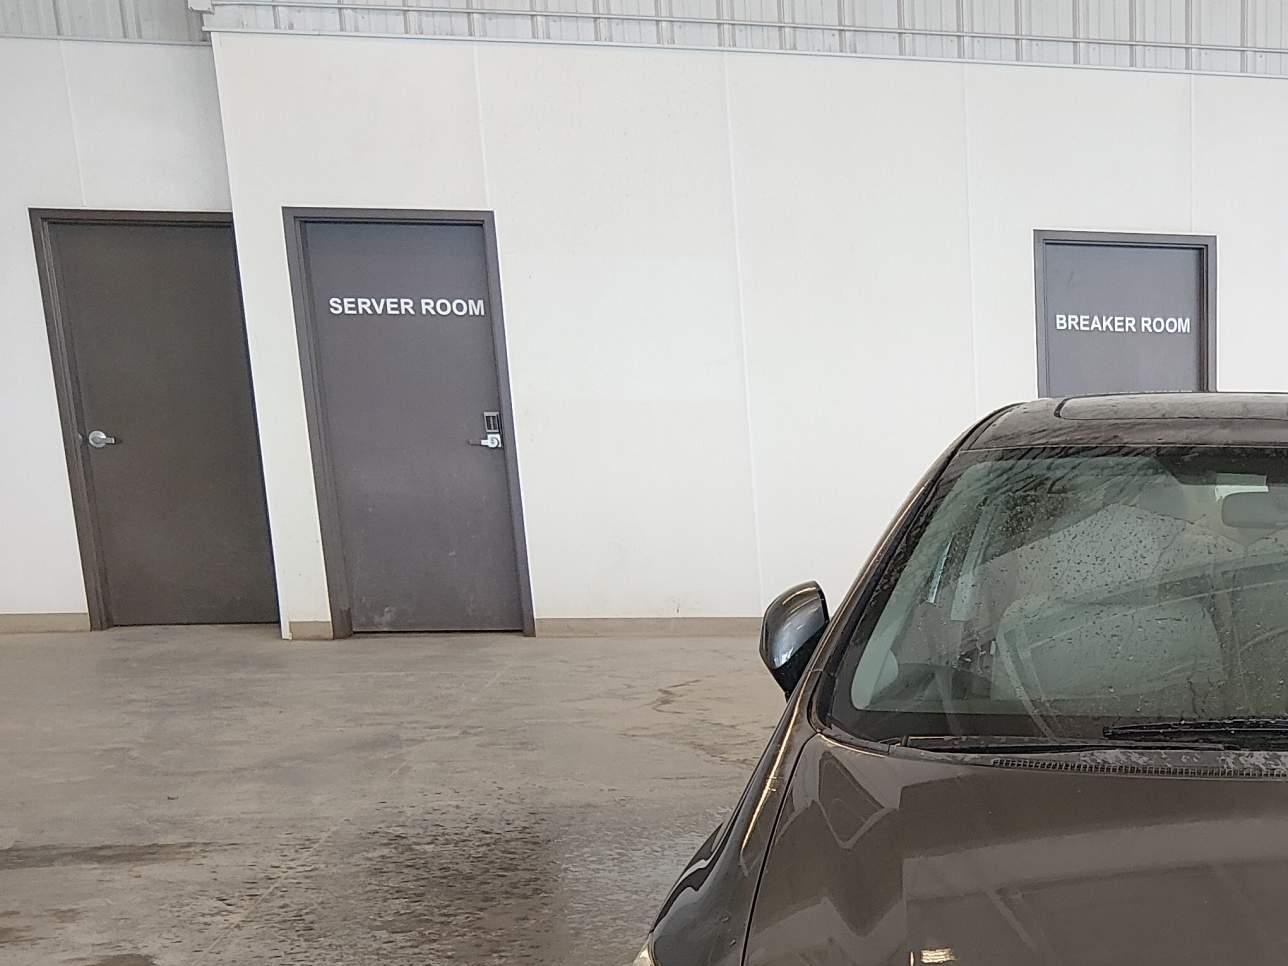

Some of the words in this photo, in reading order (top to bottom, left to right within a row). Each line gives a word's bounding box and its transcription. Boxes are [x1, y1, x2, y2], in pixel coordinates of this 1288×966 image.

[329, 298, 415, 315] SERVER
[421, 299, 486, 316] ROOM
[1055, 314, 1136, 333] BREAKER
[1141, 317, 1191, 334] ROOM
